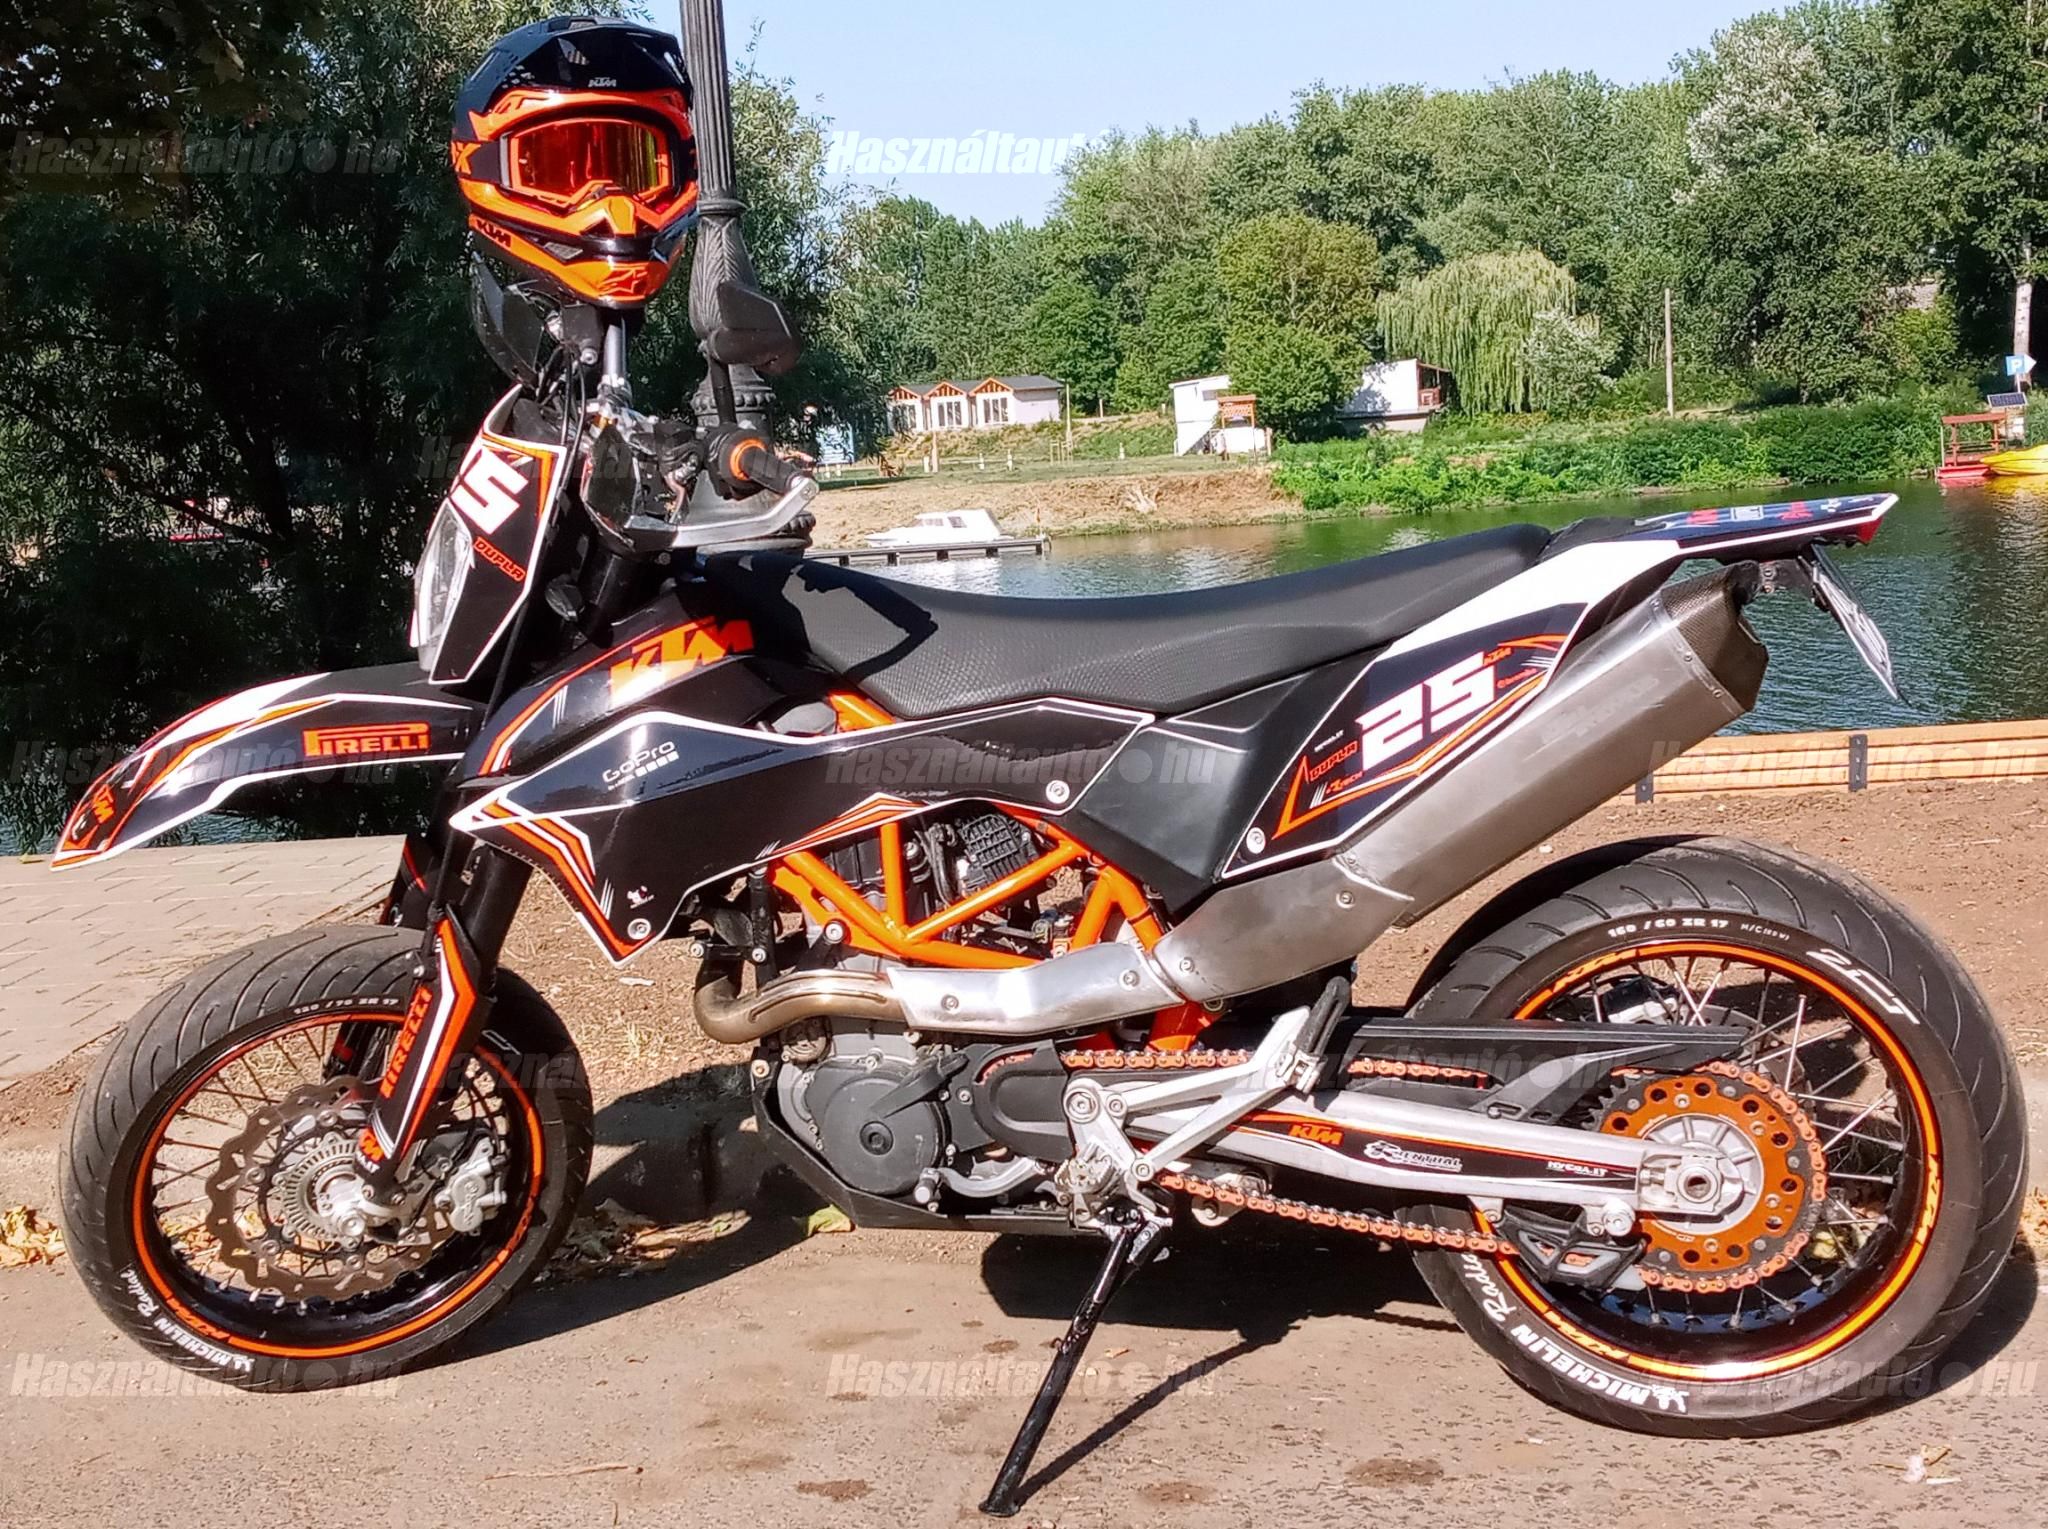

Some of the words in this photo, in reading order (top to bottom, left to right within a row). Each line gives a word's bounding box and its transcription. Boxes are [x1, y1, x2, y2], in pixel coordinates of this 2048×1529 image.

[588, 77, 617, 88] KTM
[475, 219, 512, 248] KTM
[610, 615, 754, 712] KTM
[1355, 650, 1496, 772] 25
[302, 721, 431, 758] PIRELLI
[602, 741, 676, 783] GoPro
[1288, 1123, 1344, 1146] KTM
[153, 1317, 233, 1366] MICHELIN
[1510, 1323, 1652, 1406] MICHELIN
